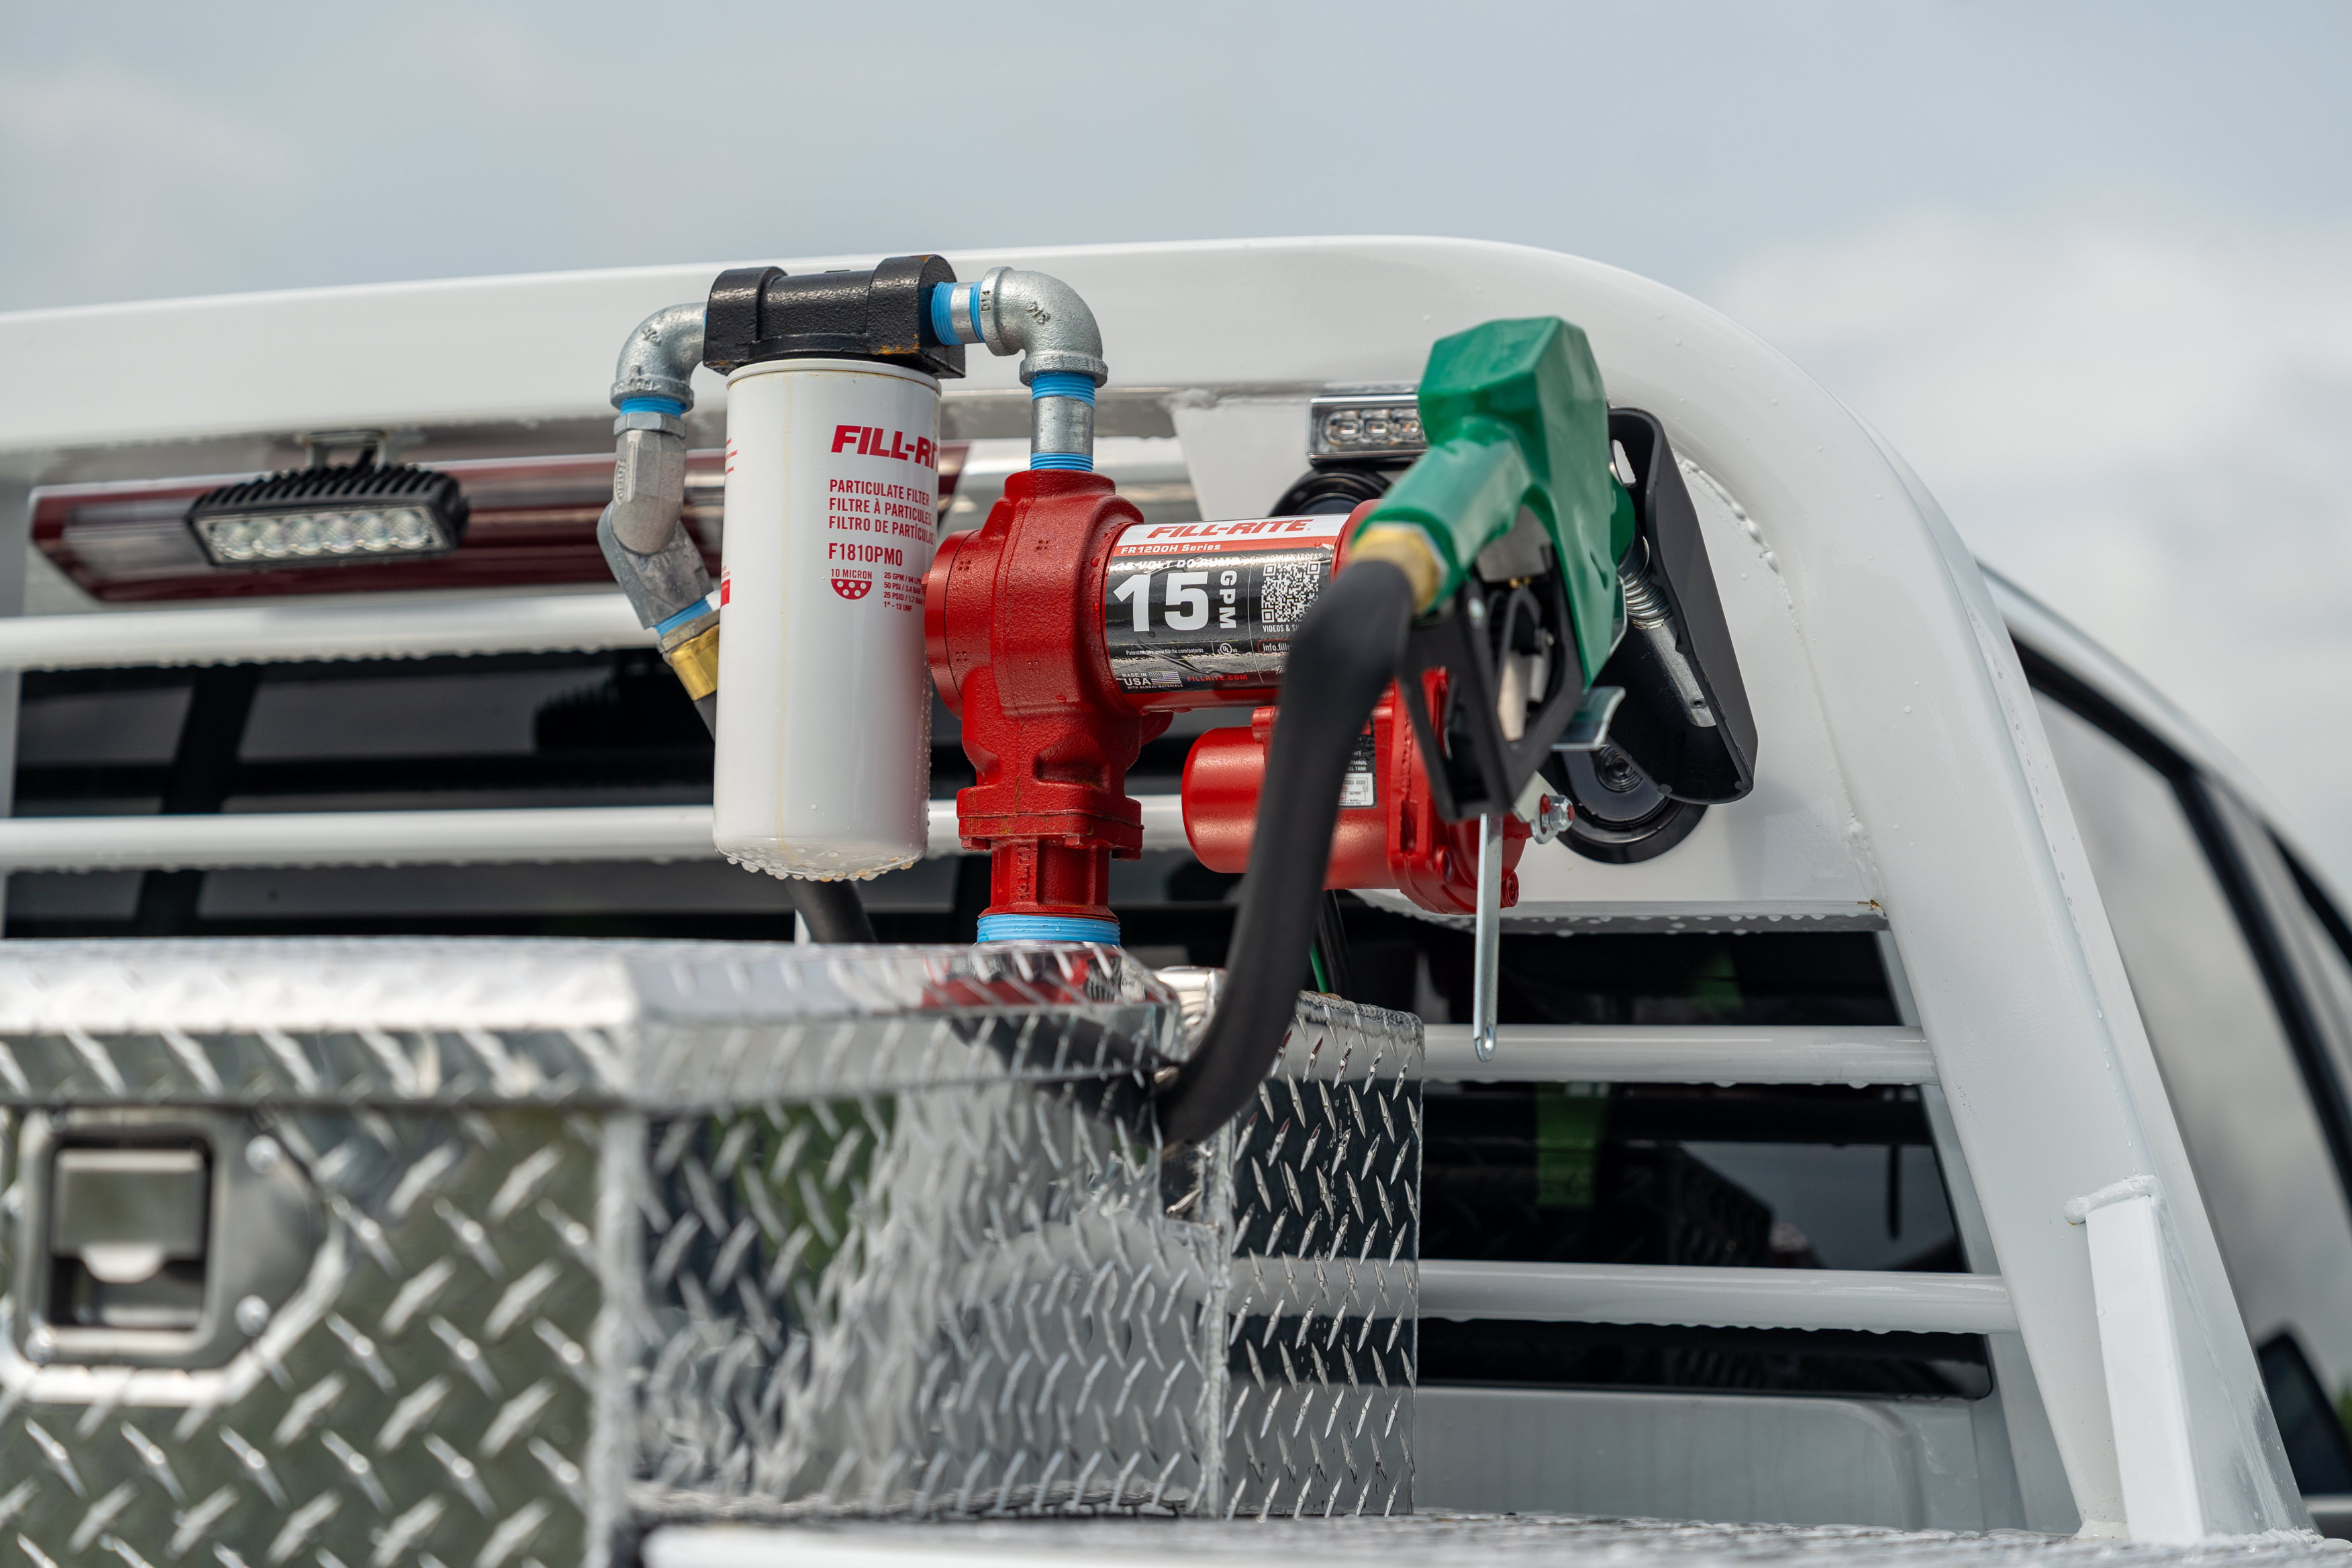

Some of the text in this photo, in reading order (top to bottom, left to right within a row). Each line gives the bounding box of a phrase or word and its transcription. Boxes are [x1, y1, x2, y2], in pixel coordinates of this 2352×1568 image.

[830, 479, 930, 506] PARTICULATE FILTER
[829, 497, 932, 526] FILTRE À PARTICULES
[829, 516, 934, 545] FILTRO DE PARTÍCULAS
[1147, 519, 1314, 538] FILL-RITE
[1120, 544, 1221, 554] FR1200H Series
[831, 569, 872, 580] 10 MICRON
[892, 573, 904, 581] GPM
[892, 583, 901, 591] PSI
[892, 592, 903, 601] PSID
[1113, 571, 1209, 632] 15
[1219, 570, 1237, 629] GPM
[1285, 624, 1290, 632] &
[1263, 642, 1291, 652] info.fillr
[1124, 677, 1152, 686] USA
[1187, 674, 1248, 683] FILLRITE.COM
